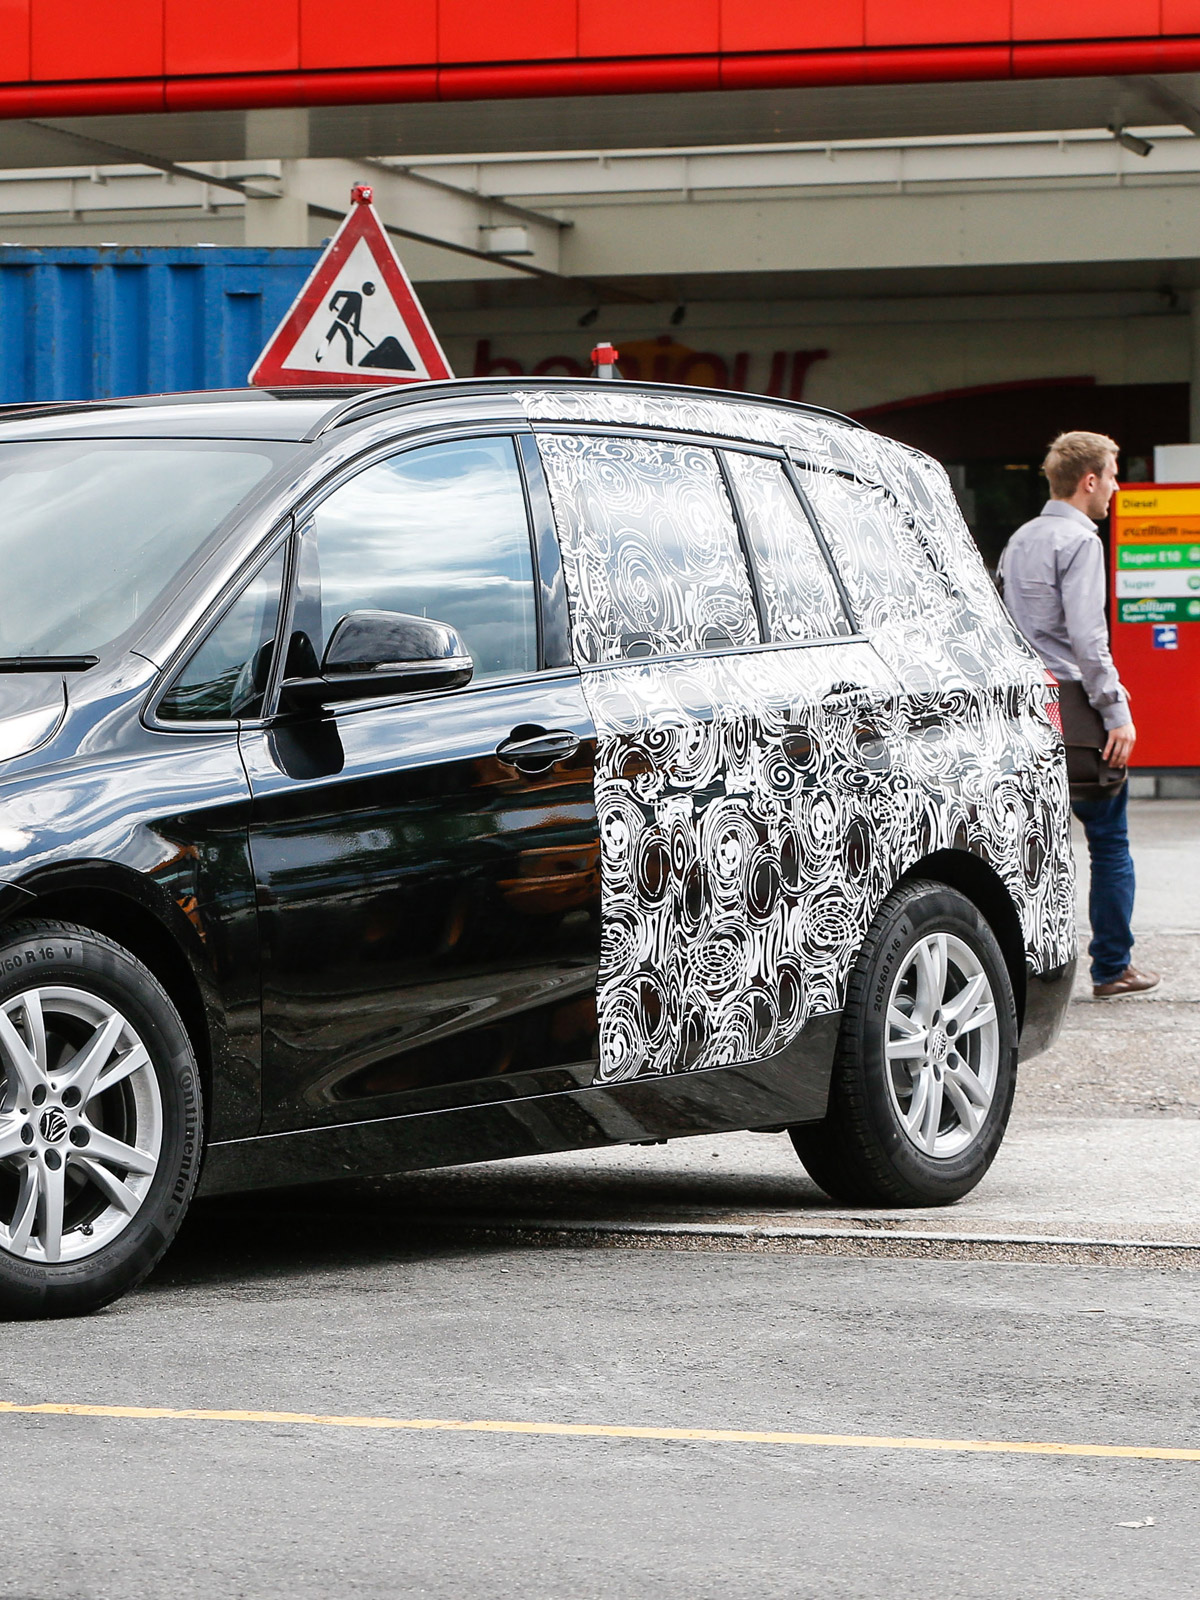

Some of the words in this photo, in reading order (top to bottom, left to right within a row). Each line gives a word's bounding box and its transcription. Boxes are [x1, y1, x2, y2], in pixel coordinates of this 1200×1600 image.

[1122, 499, 1158, 509] Diesel
[1123, 525, 1178, 537] excellium
[1121, 551, 1157, 565] Super
[1159, 551, 1182, 562] E10
[1123, 580, 1156, 590] Super
[1122, 600, 1176, 614] excellium
[25, 950, 37, 963] R
[39, 947, 54, 960] 16
[63, 947, 72, 959] V
[874, 965, 890, 1012] 205/60
[886, 953, 895, 964] R
[892, 939, 901, 952] 16
[901, 925, 909, 936] V
[171, 1065, 195, 1204] Continental
